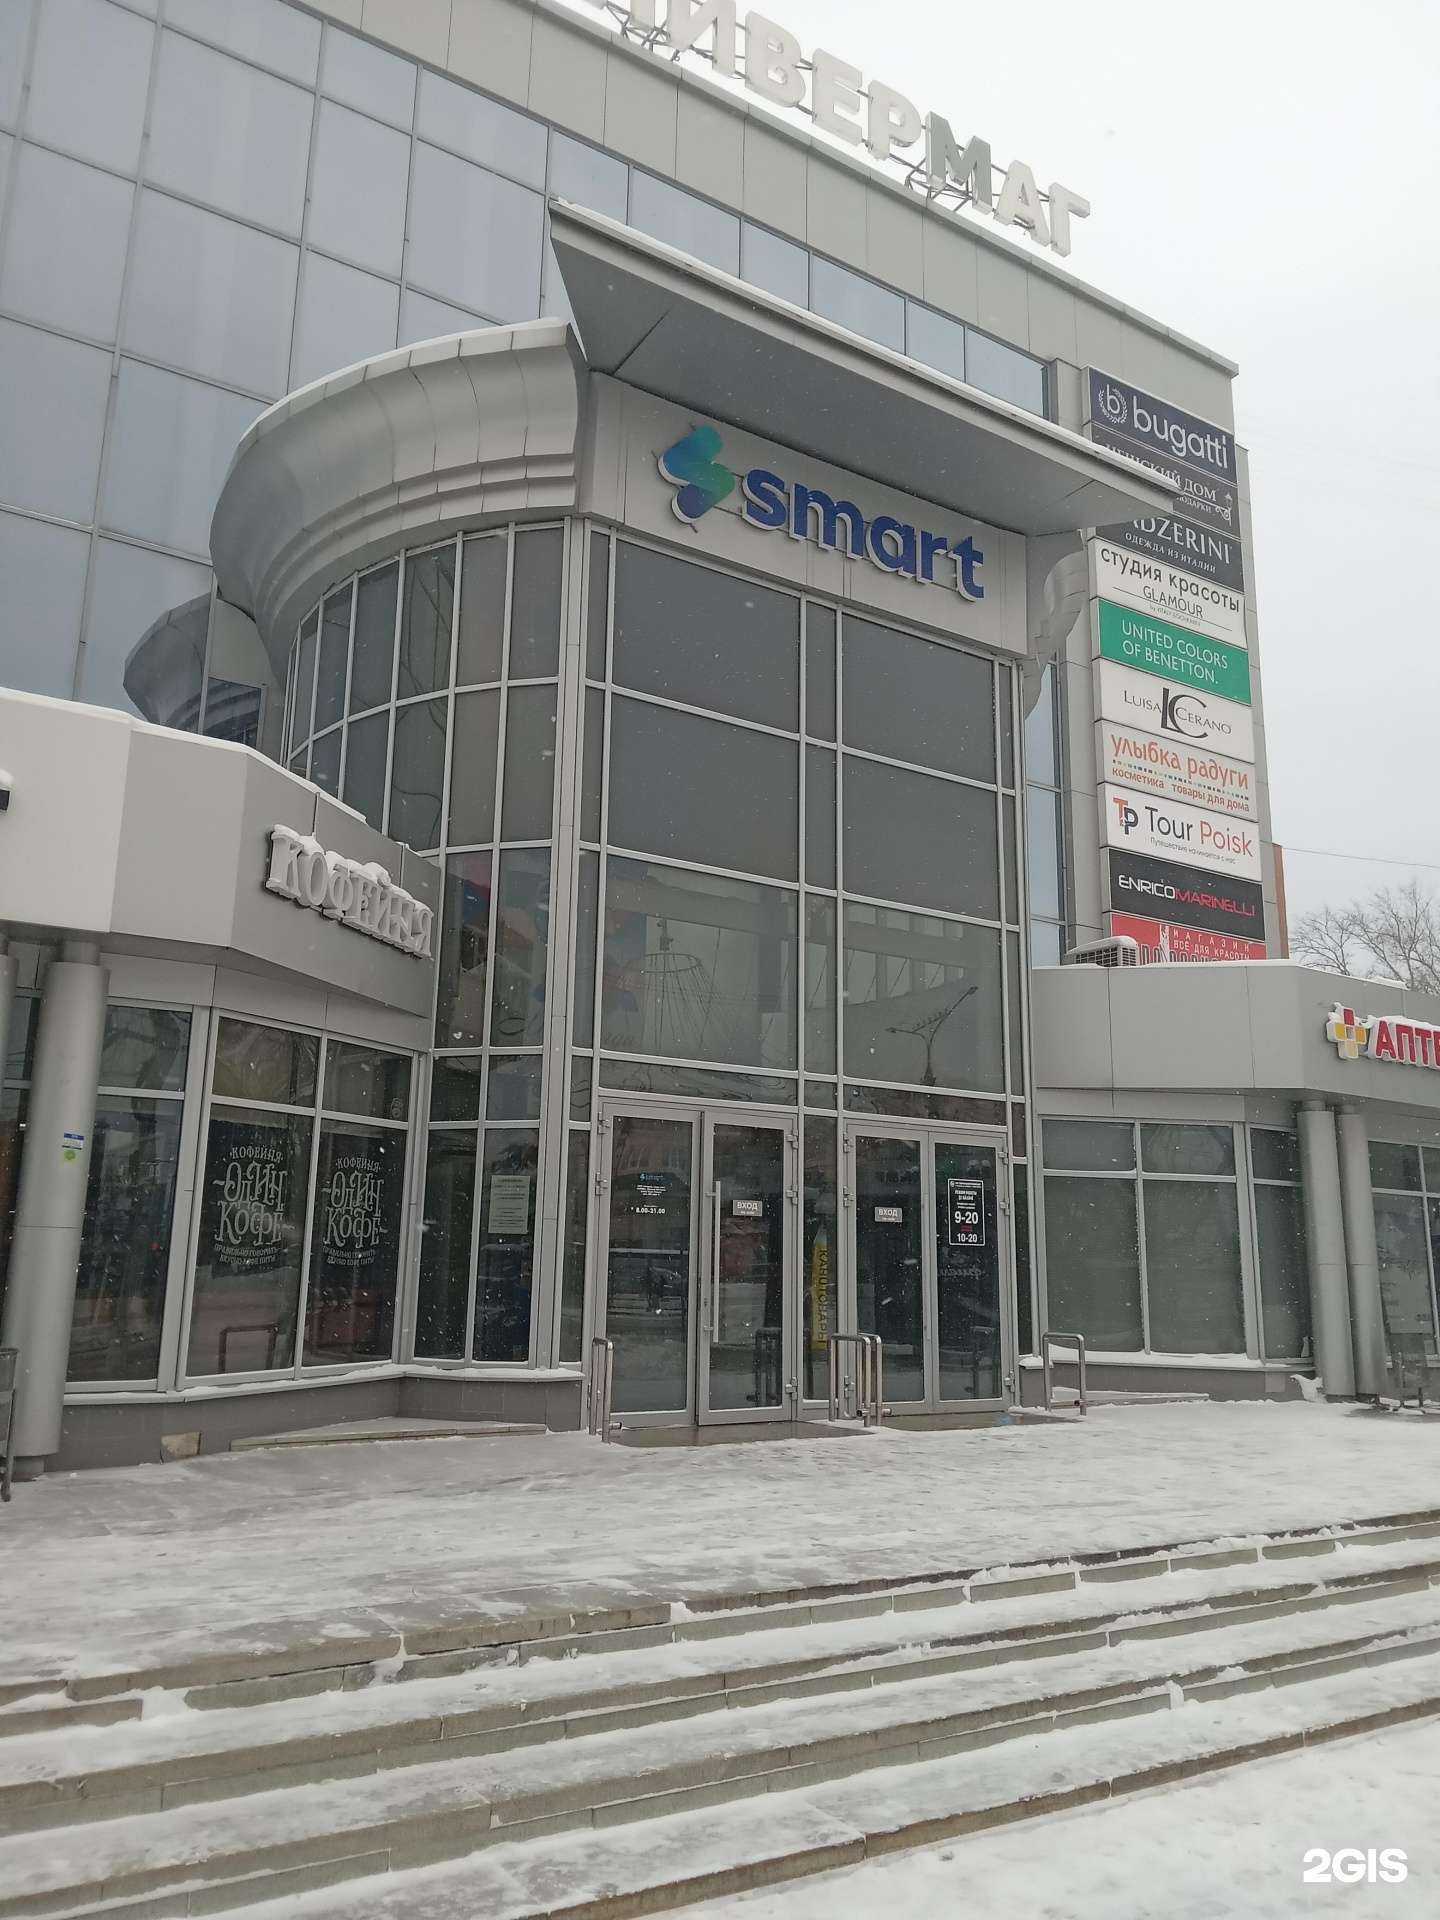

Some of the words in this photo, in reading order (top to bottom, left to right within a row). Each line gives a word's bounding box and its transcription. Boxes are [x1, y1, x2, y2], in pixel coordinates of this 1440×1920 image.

[588, 0, 1091, 258] ИВЕРМАГ
[1132, 395, 1228, 469] bugatti
[1183, 478, 1217, 502] ДОМ
[742, 468, 985, 603] smart
[1125, 532, 1165, 554] ОДЕЖДА
[1167, 547, 1180, 559] ИЗ
[1181, 552, 1216, 574] ИТАЛИИ
[1132, 517, 1231, 564] DZERINI
[1142, 585, 1204, 619] GLAMOUR
[1122, 619, 1174, 649] UNITED
[1176, 639, 1229, 669] COLORS
[1122, 640, 1142, 657] OF
[1145, 647, 1219, 684] BENETTON.
[1111, 734, 1182, 771] улыбка
[1187, 756, 1249, 790] радуги
[1112, 767, 1165, 789] косметика
[1171, 783, 1208, 801] товары
[1207, 793, 1226, 806] для
[1226, 800, 1250, 812] дома
[1144, 805, 1194, 841] Tour
[1199, 820, 1253, 857] Poisk
[1194, 943, 1210, 955] ДЛЯ
[737, 1201, 758, 1211] ВХОД
[878, 1208, 898, 1217] ВХОД
[954, 1210, 979, 1225] 9-20
[956, 1232, 978, 1243] 10-20
